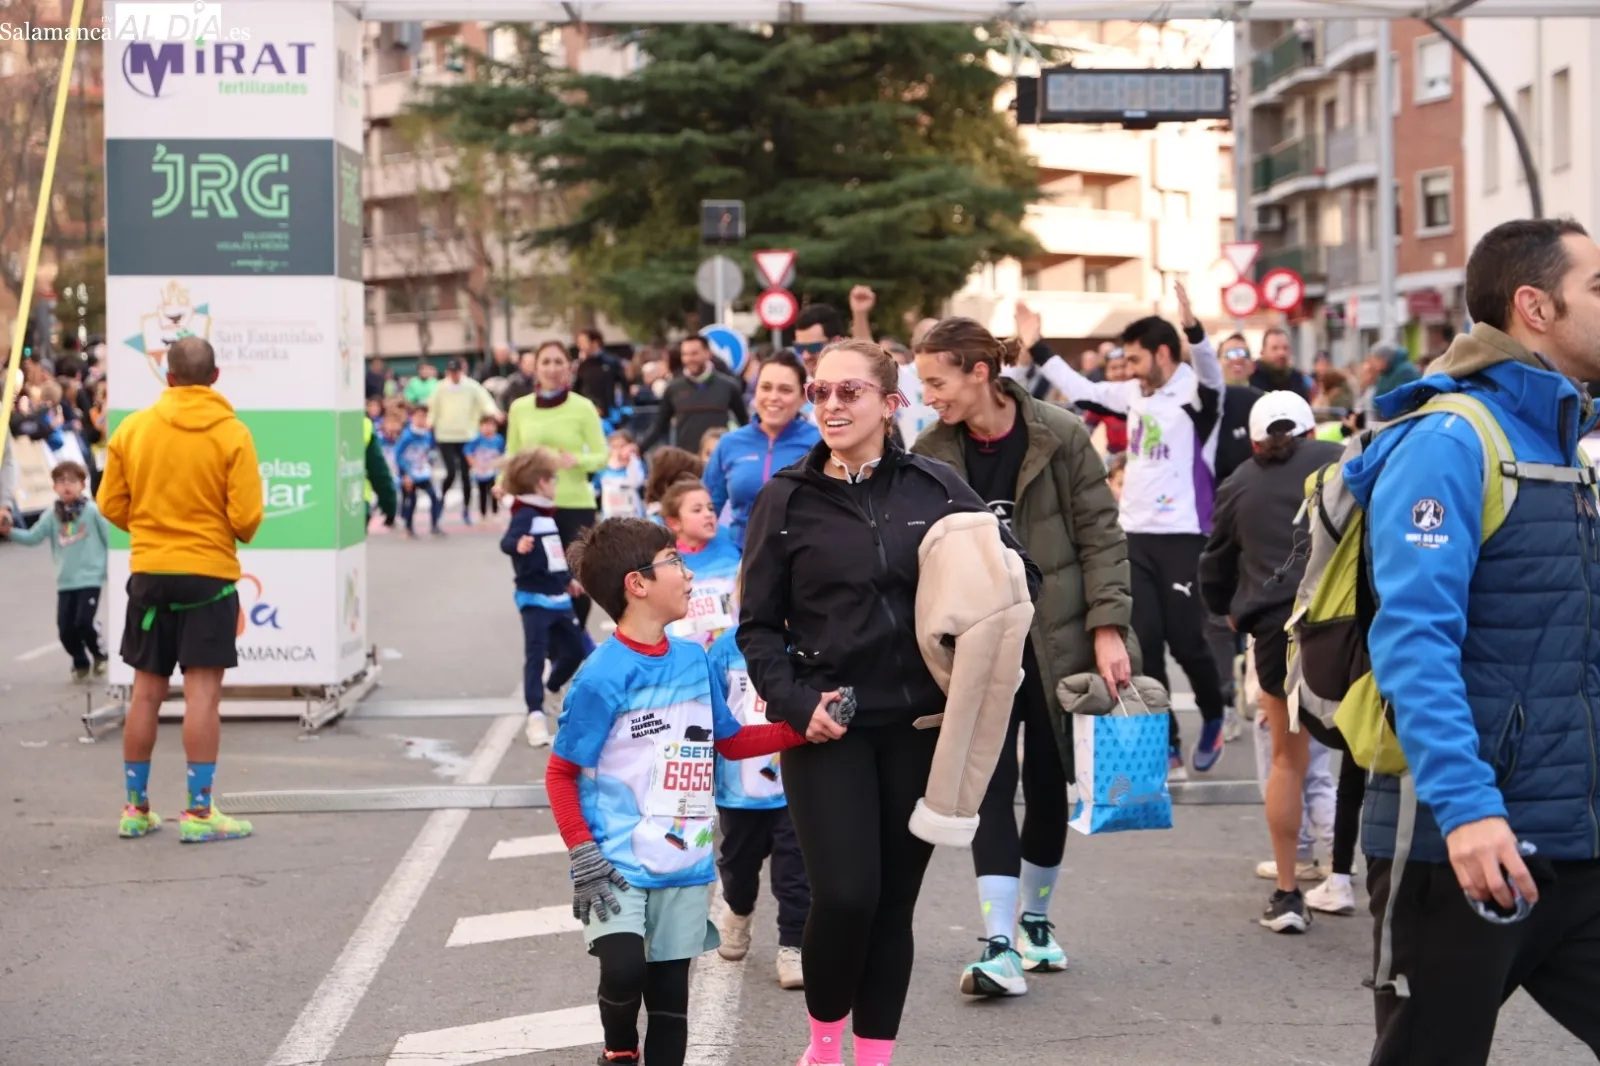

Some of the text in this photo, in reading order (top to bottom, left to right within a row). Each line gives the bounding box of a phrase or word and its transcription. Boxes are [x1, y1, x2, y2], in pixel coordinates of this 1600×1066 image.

[218, 80, 308, 95] fertilizantes
[258, 458, 312, 479] elas
[262, 476, 313, 507] lar
[687, 597, 715, 618] 859
[237, 646, 317, 661] AMANCA
[642, 712, 655, 721] SAN
[630, 719, 663, 732] SILVESTRE
[680, 746, 714, 758] SETE
[663, 761, 713, 791] 6955
